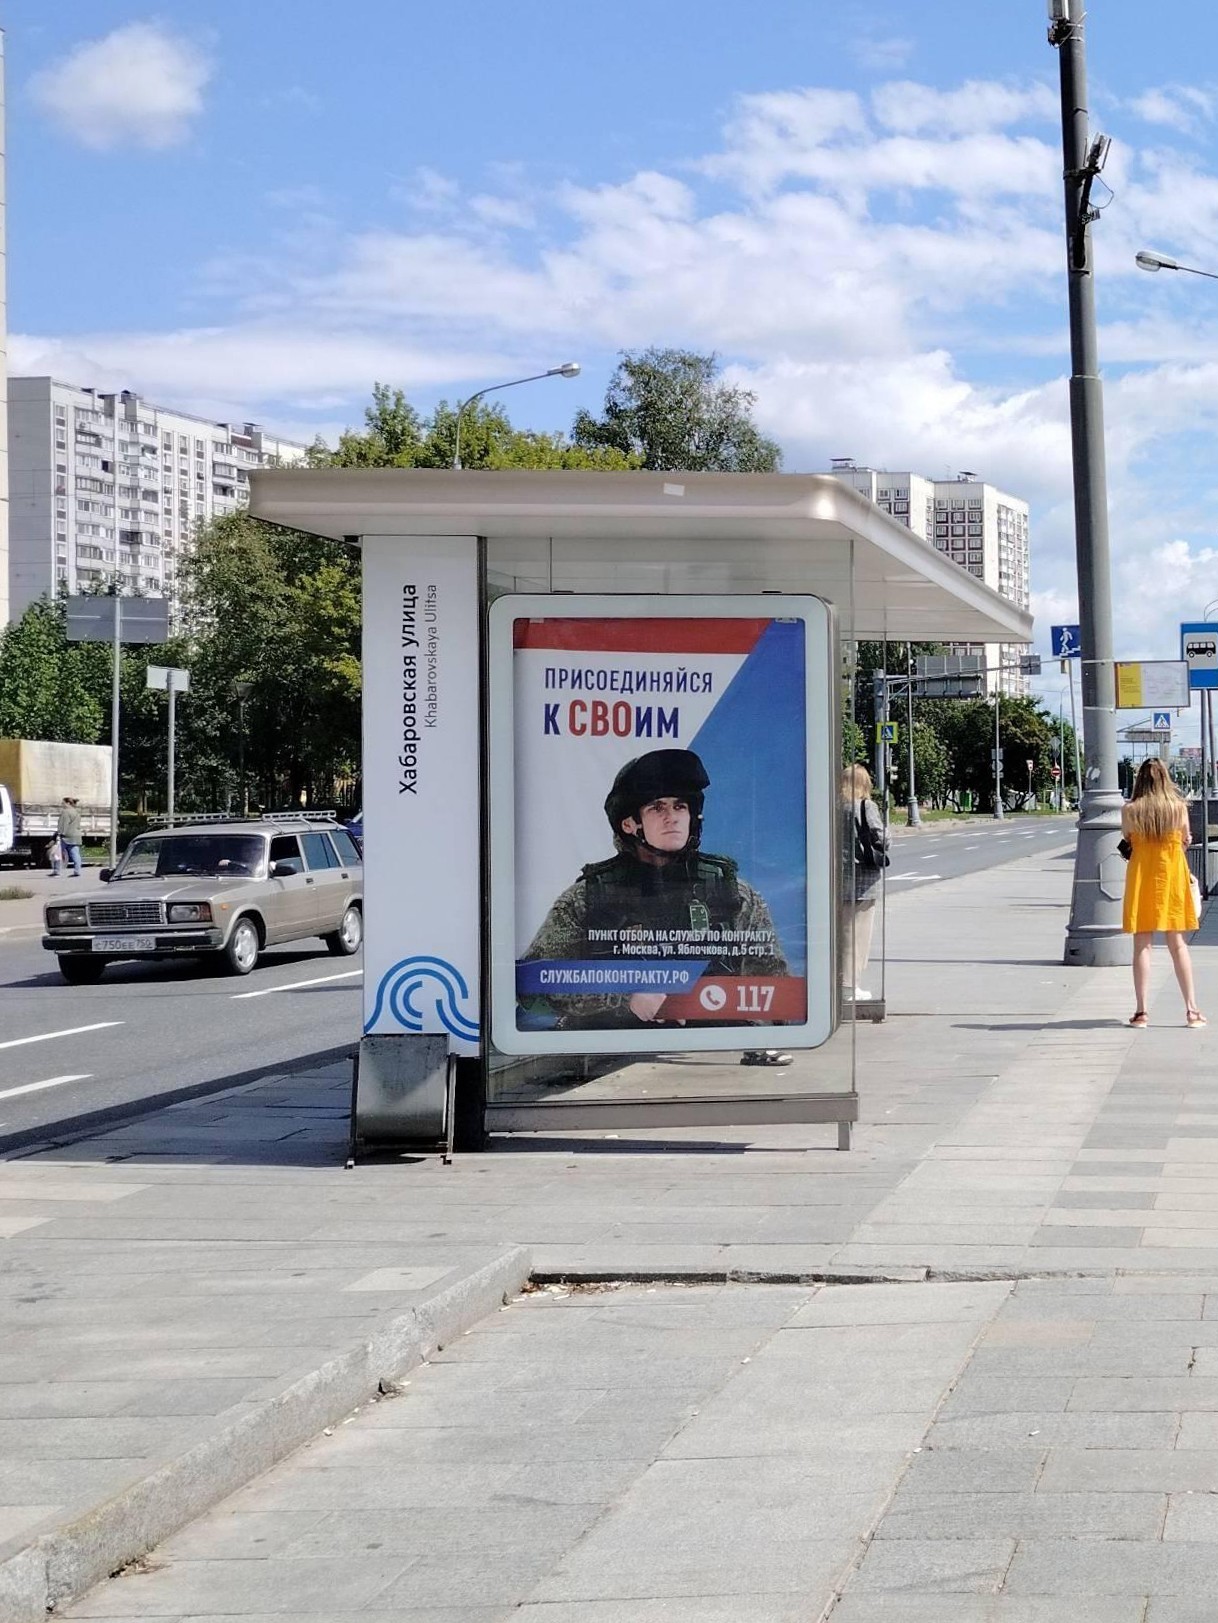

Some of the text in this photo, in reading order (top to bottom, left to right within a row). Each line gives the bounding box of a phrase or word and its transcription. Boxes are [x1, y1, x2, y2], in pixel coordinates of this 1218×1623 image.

[424, 584, 440, 728] Khabarovskaya Ulitsa
[399, 584, 421, 795] Хабаровская улица
[545, 667, 713, 694] ПРИСОЕДИНЯЙСЯ
[544, 703, 560, 735] К
[588, 929, 775, 942] ПУНКТ ОТБОРА НА СЛУЖБУ ПО КОНТРАКТУ:
[613, 946, 620, 955] г.
[622, 944, 661, 956] Москва,
[662, 945, 675, 957] ул.
[677, 944, 730, 957] Яблочкова,
[748, 944, 767, 957] стр.
[769, 944, 774, 955] 1
[540, 969, 689, 984] СЛУЖБАПОКОНТРАКТУ.РФ
[737, 985, 775, 1011] 117
